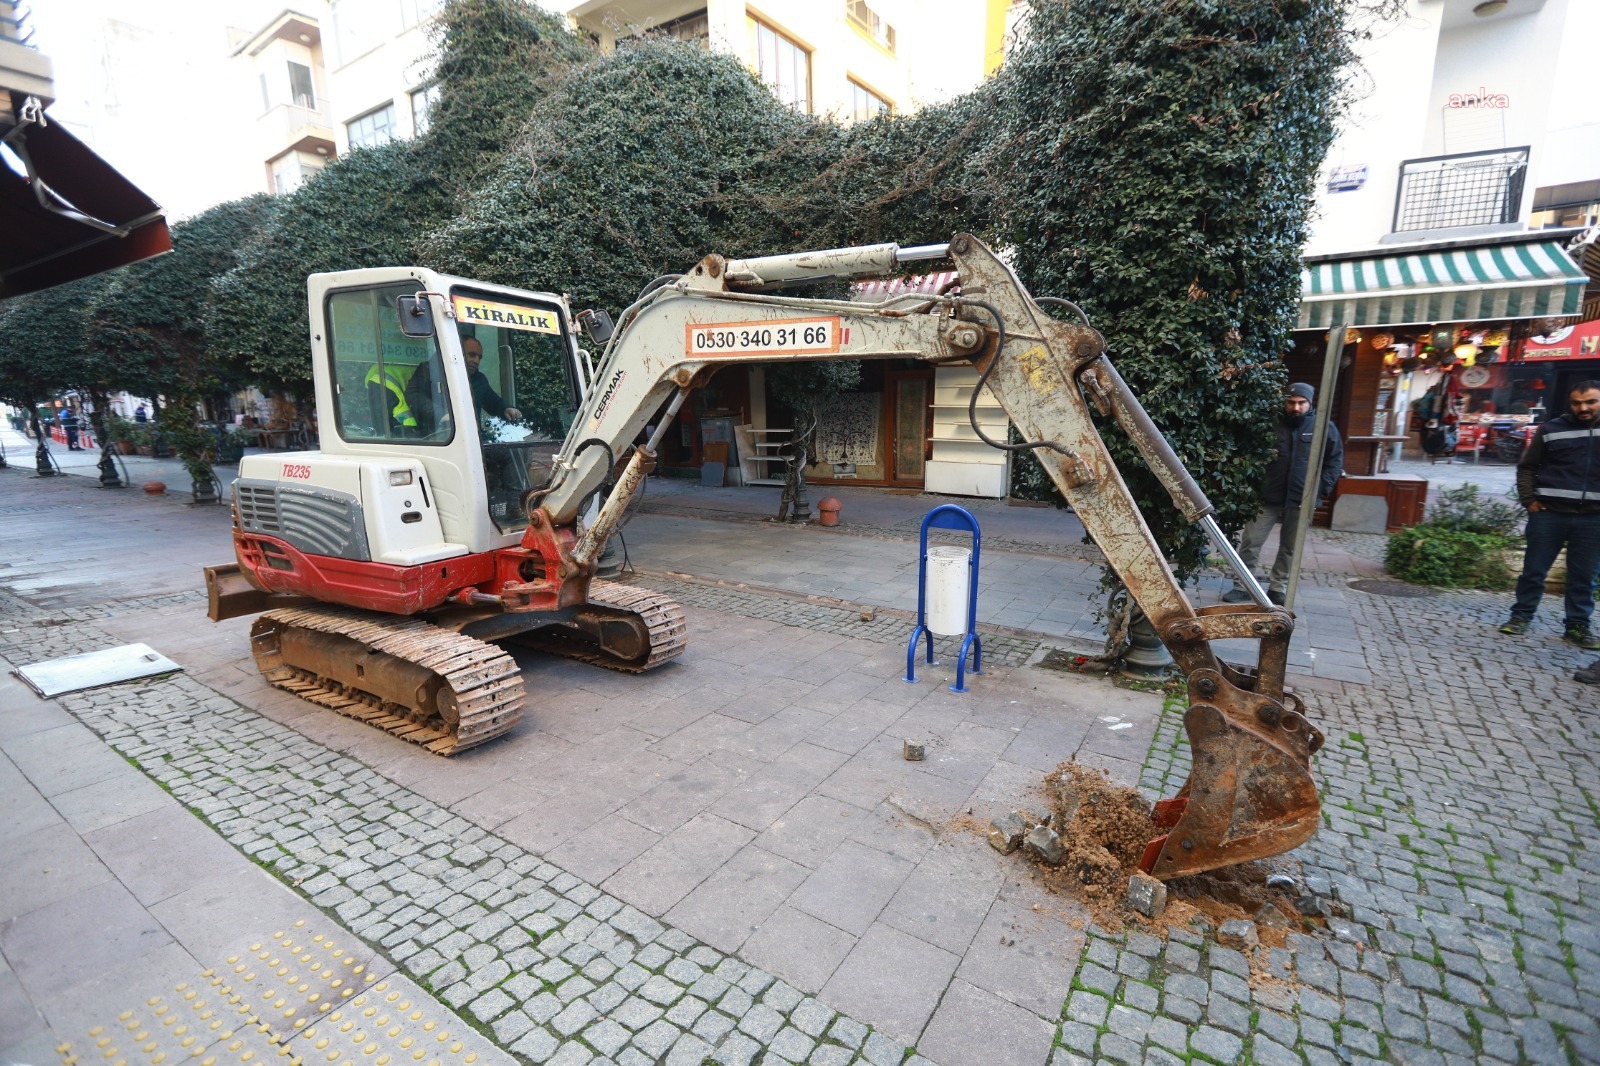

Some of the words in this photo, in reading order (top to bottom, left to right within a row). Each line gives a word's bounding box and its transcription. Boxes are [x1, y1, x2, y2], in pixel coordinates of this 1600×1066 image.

[465, 305, 550, 329] KİRALIK
[696, 331, 735, 348] 0530
[740, 329, 772, 347] 340
[777, 328, 796, 346] 31
[803, 326, 826, 344] 66
[594, 368, 624, 420] CERMAK
[283, 464, 311, 479] TB235
